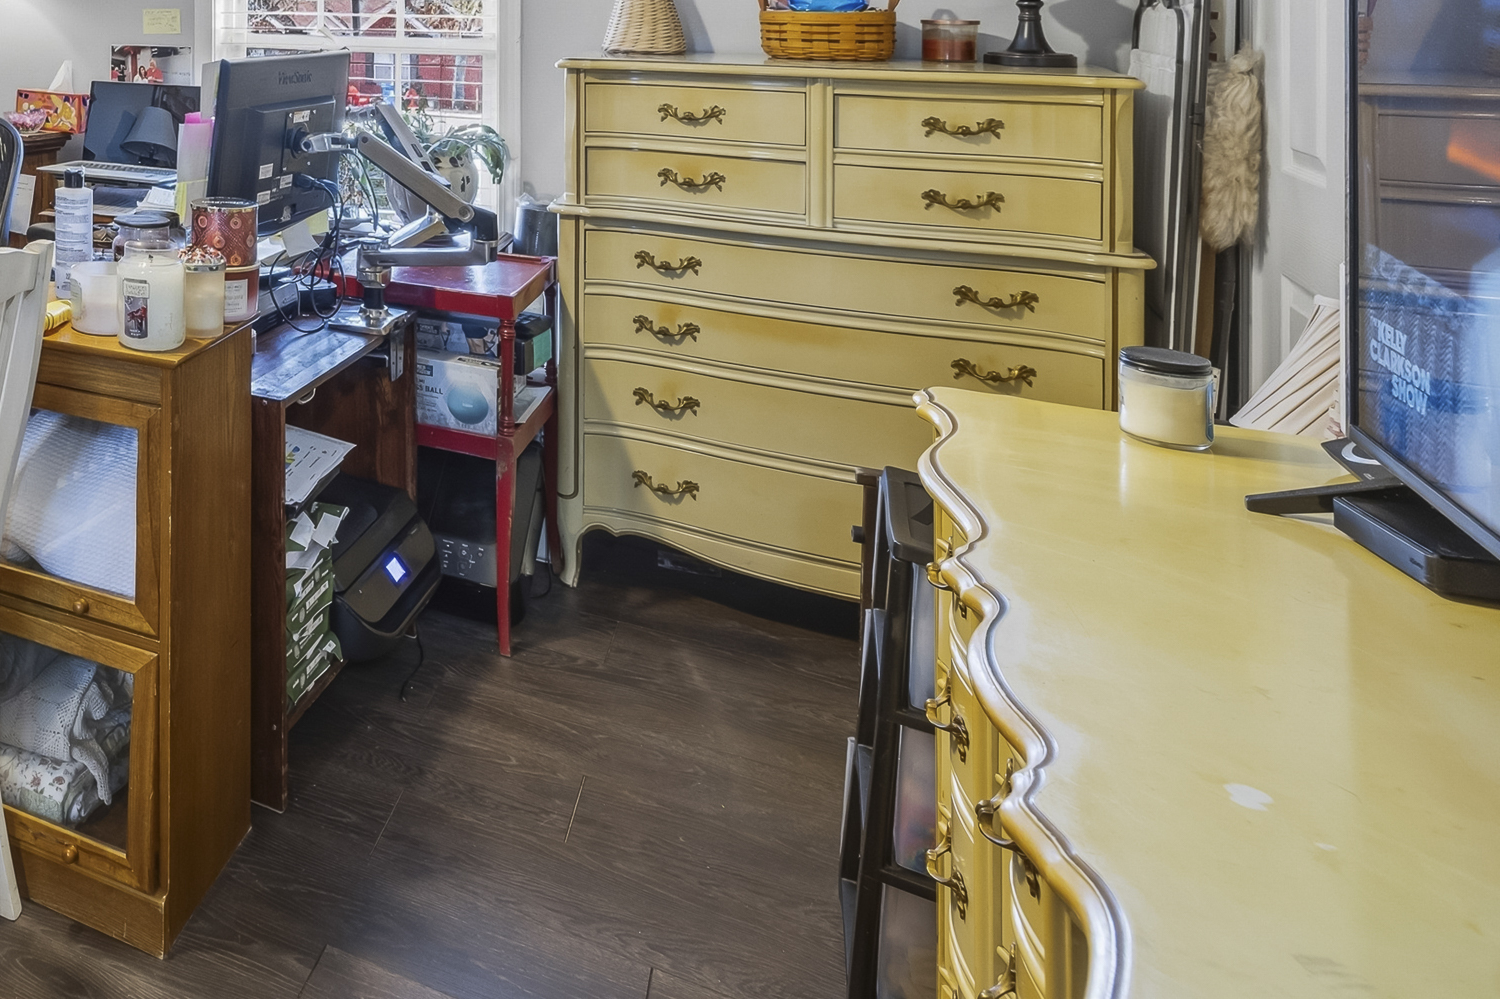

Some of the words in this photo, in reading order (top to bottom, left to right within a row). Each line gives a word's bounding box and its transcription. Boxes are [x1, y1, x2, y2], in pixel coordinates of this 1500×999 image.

[278, 70, 313, 85] ViewSonic
[1377, 322, 1407, 357] KELLY
[1370, 337, 1431, 396] CLARKSON
[425, 386, 444, 395] BALL
[1391, 374, 1429, 417] SHOW
